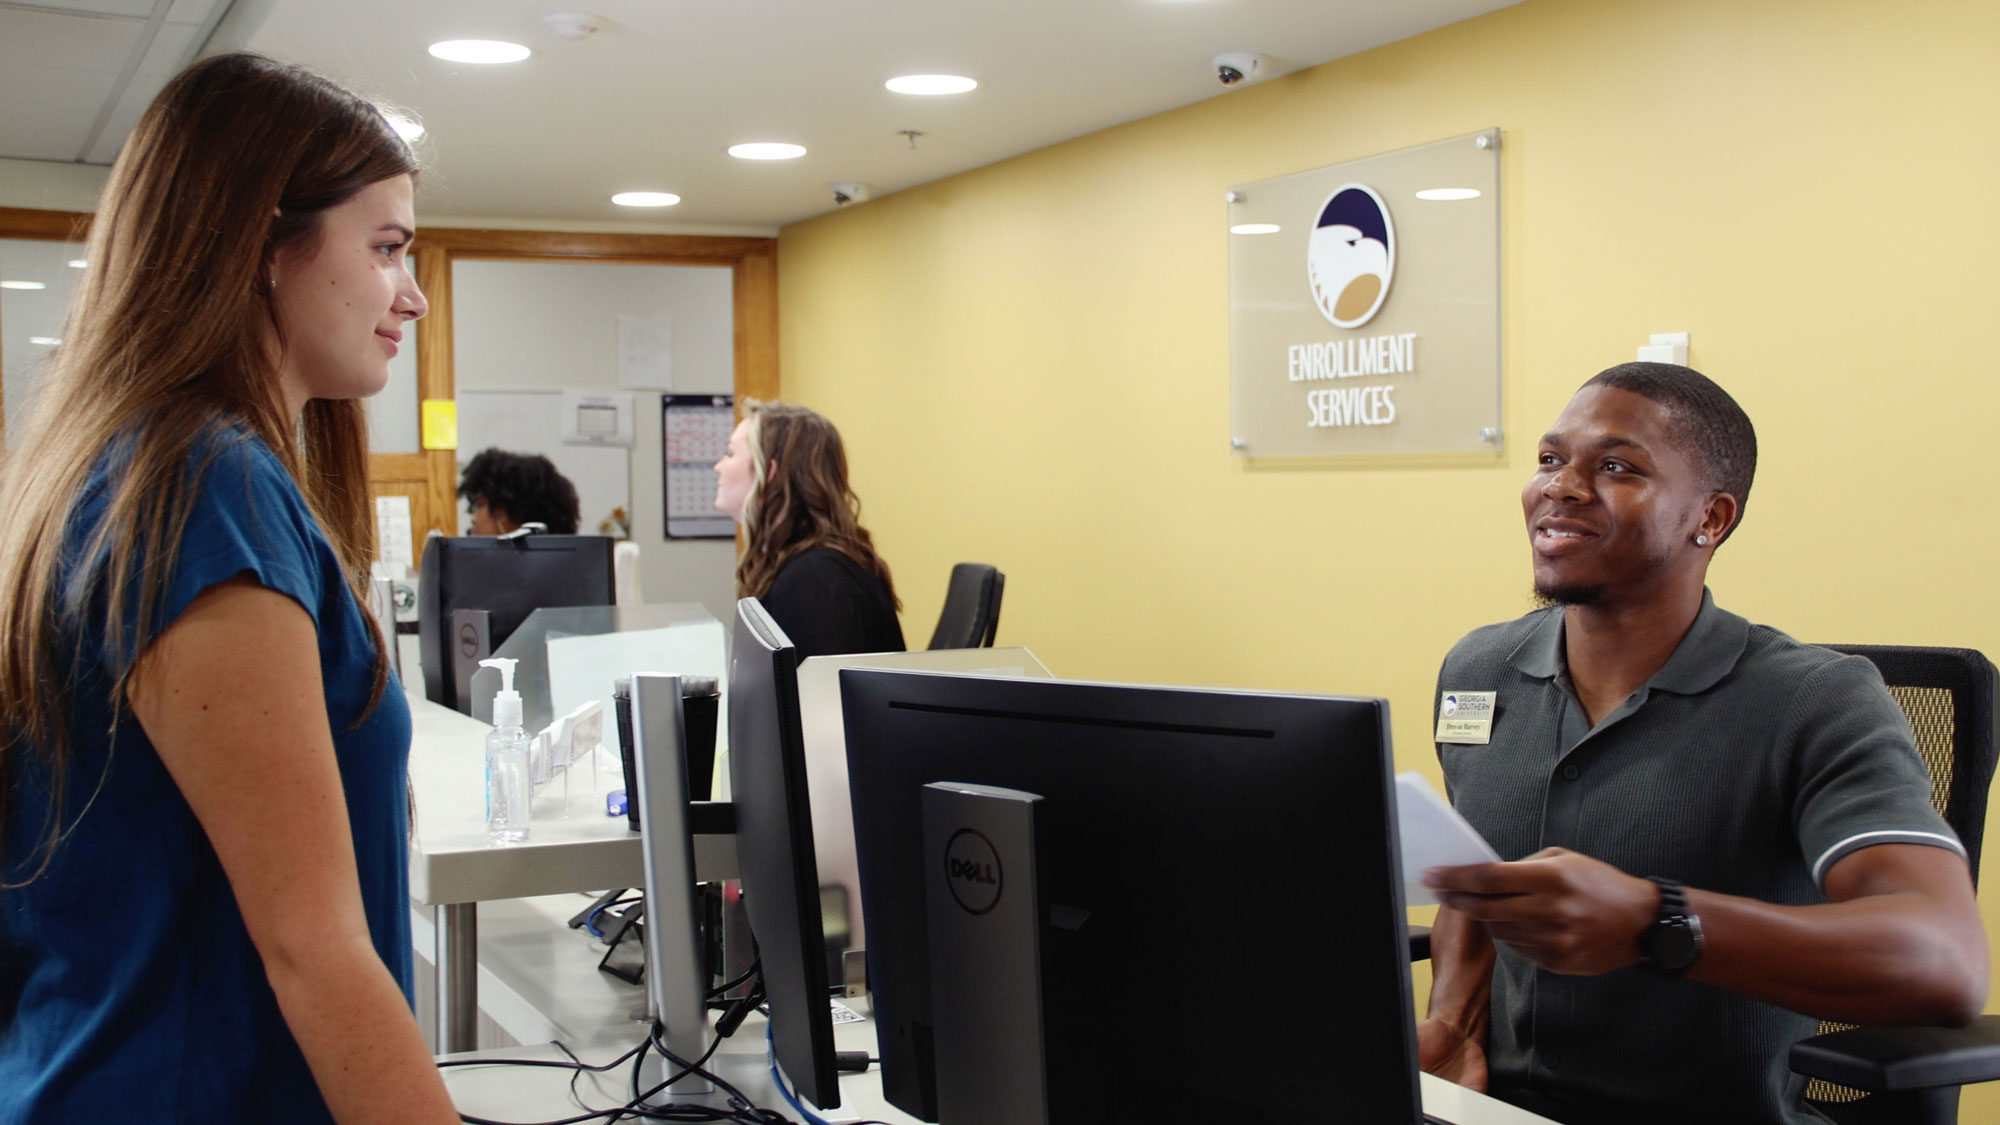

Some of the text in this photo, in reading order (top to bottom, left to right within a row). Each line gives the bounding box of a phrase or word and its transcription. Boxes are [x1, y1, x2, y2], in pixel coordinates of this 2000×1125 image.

[1288, 332, 1416, 381] ENROLLMENT
[1307, 385, 1396, 427] SERVICES
[1458, 703, 1490, 711] SOUTHERN
[951, 858, 996, 885] DELL
